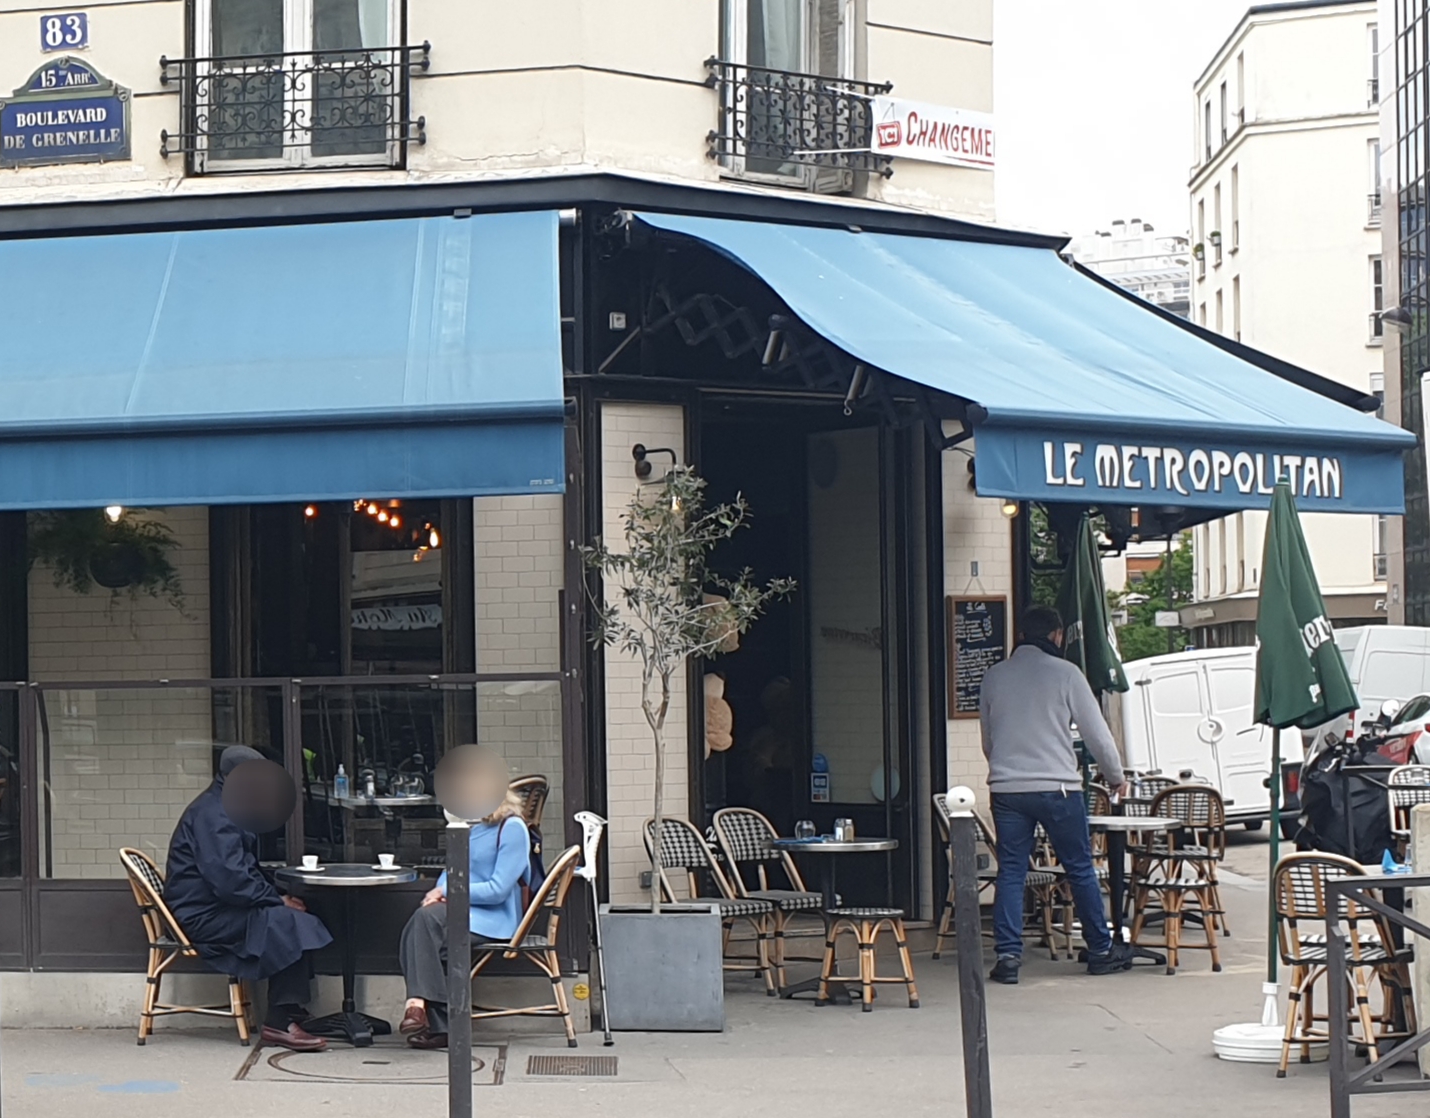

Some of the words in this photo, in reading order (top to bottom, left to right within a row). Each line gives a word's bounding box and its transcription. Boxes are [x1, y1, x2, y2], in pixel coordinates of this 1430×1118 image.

[45, 15, 83, 47] 83
[16, 107, 107, 128] BOULEVARD
[3, 135, 26, 149] DE
[32, 128, 121, 148] GRENELLE
[906, 111, 996, 158] CHANGEME
[1043, 441, 1085, 486] LE
[1095, 443, 1342, 498] METROPOLITAN
